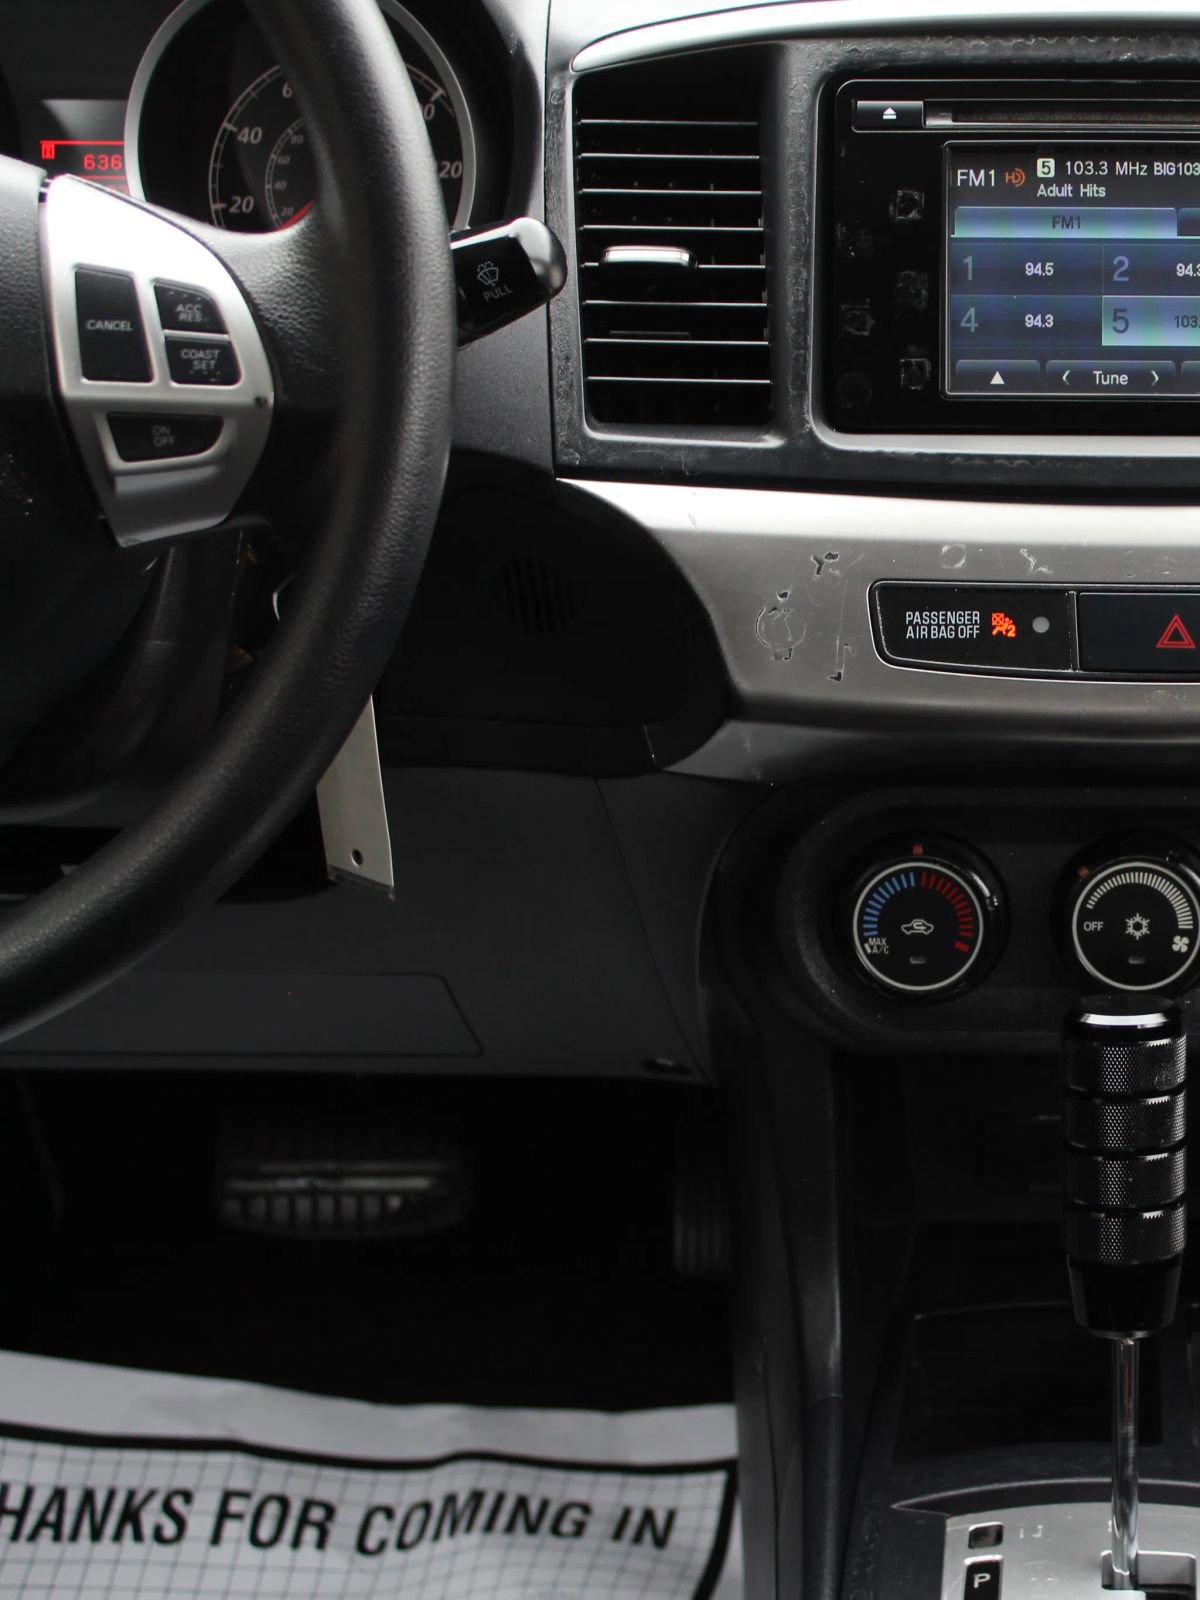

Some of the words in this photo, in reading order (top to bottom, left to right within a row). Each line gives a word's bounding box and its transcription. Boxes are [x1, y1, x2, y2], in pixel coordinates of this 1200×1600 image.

[237, 127, 263, 144] 40
[83, 153, 123, 170] 636
[1039, 159, 1054, 177] 5
[1065, 160, 1109, 176] 103.3
[1115, 161, 1148, 176] MHz
[439, 161, 463, 179] 20
[956, 168, 997, 187] FM1
[1036, 183, 1073, 198] Adult
[1080, 183, 1106, 198] Hits
[229, 195, 254, 214] 20
[1051, 215, 1082, 230] FM1
[963, 255, 974, 281] 1
[1024, 262, 1054, 276] 94.5
[1112, 256, 1130, 281] 2
[483, 286, 513, 302] PULL
[176, 303, 202, 313] ACC
[86, 319, 133, 332] CANCEL
[959, 307, 979, 333] 4
[1024, 314, 1054, 328] 94.3
[1112, 308, 1130, 334] 5
[181, 348, 221, 360] COAST
[193, 359, 216, 370] SET
[1093, 370, 1129, 385] Tune
[905, 610, 980, 625] PASSENGER
[905, 626, 928, 639] AIR
[930, 626, 955, 639] BAG
[958, 626, 980, 639] OFF
[1083, 921, 1104, 932] OFF
[868, 937, 887, 946] MAX
[872, 945, 889, 954] A/C
[0, 1482, 196, 1546] HANKS
[210, 1489, 338, 1552] FOR
[356, 1489, 593, 1557] COMING
[611, 1505, 677, 1550] IN
[972, 1572, 992, 1589] P
